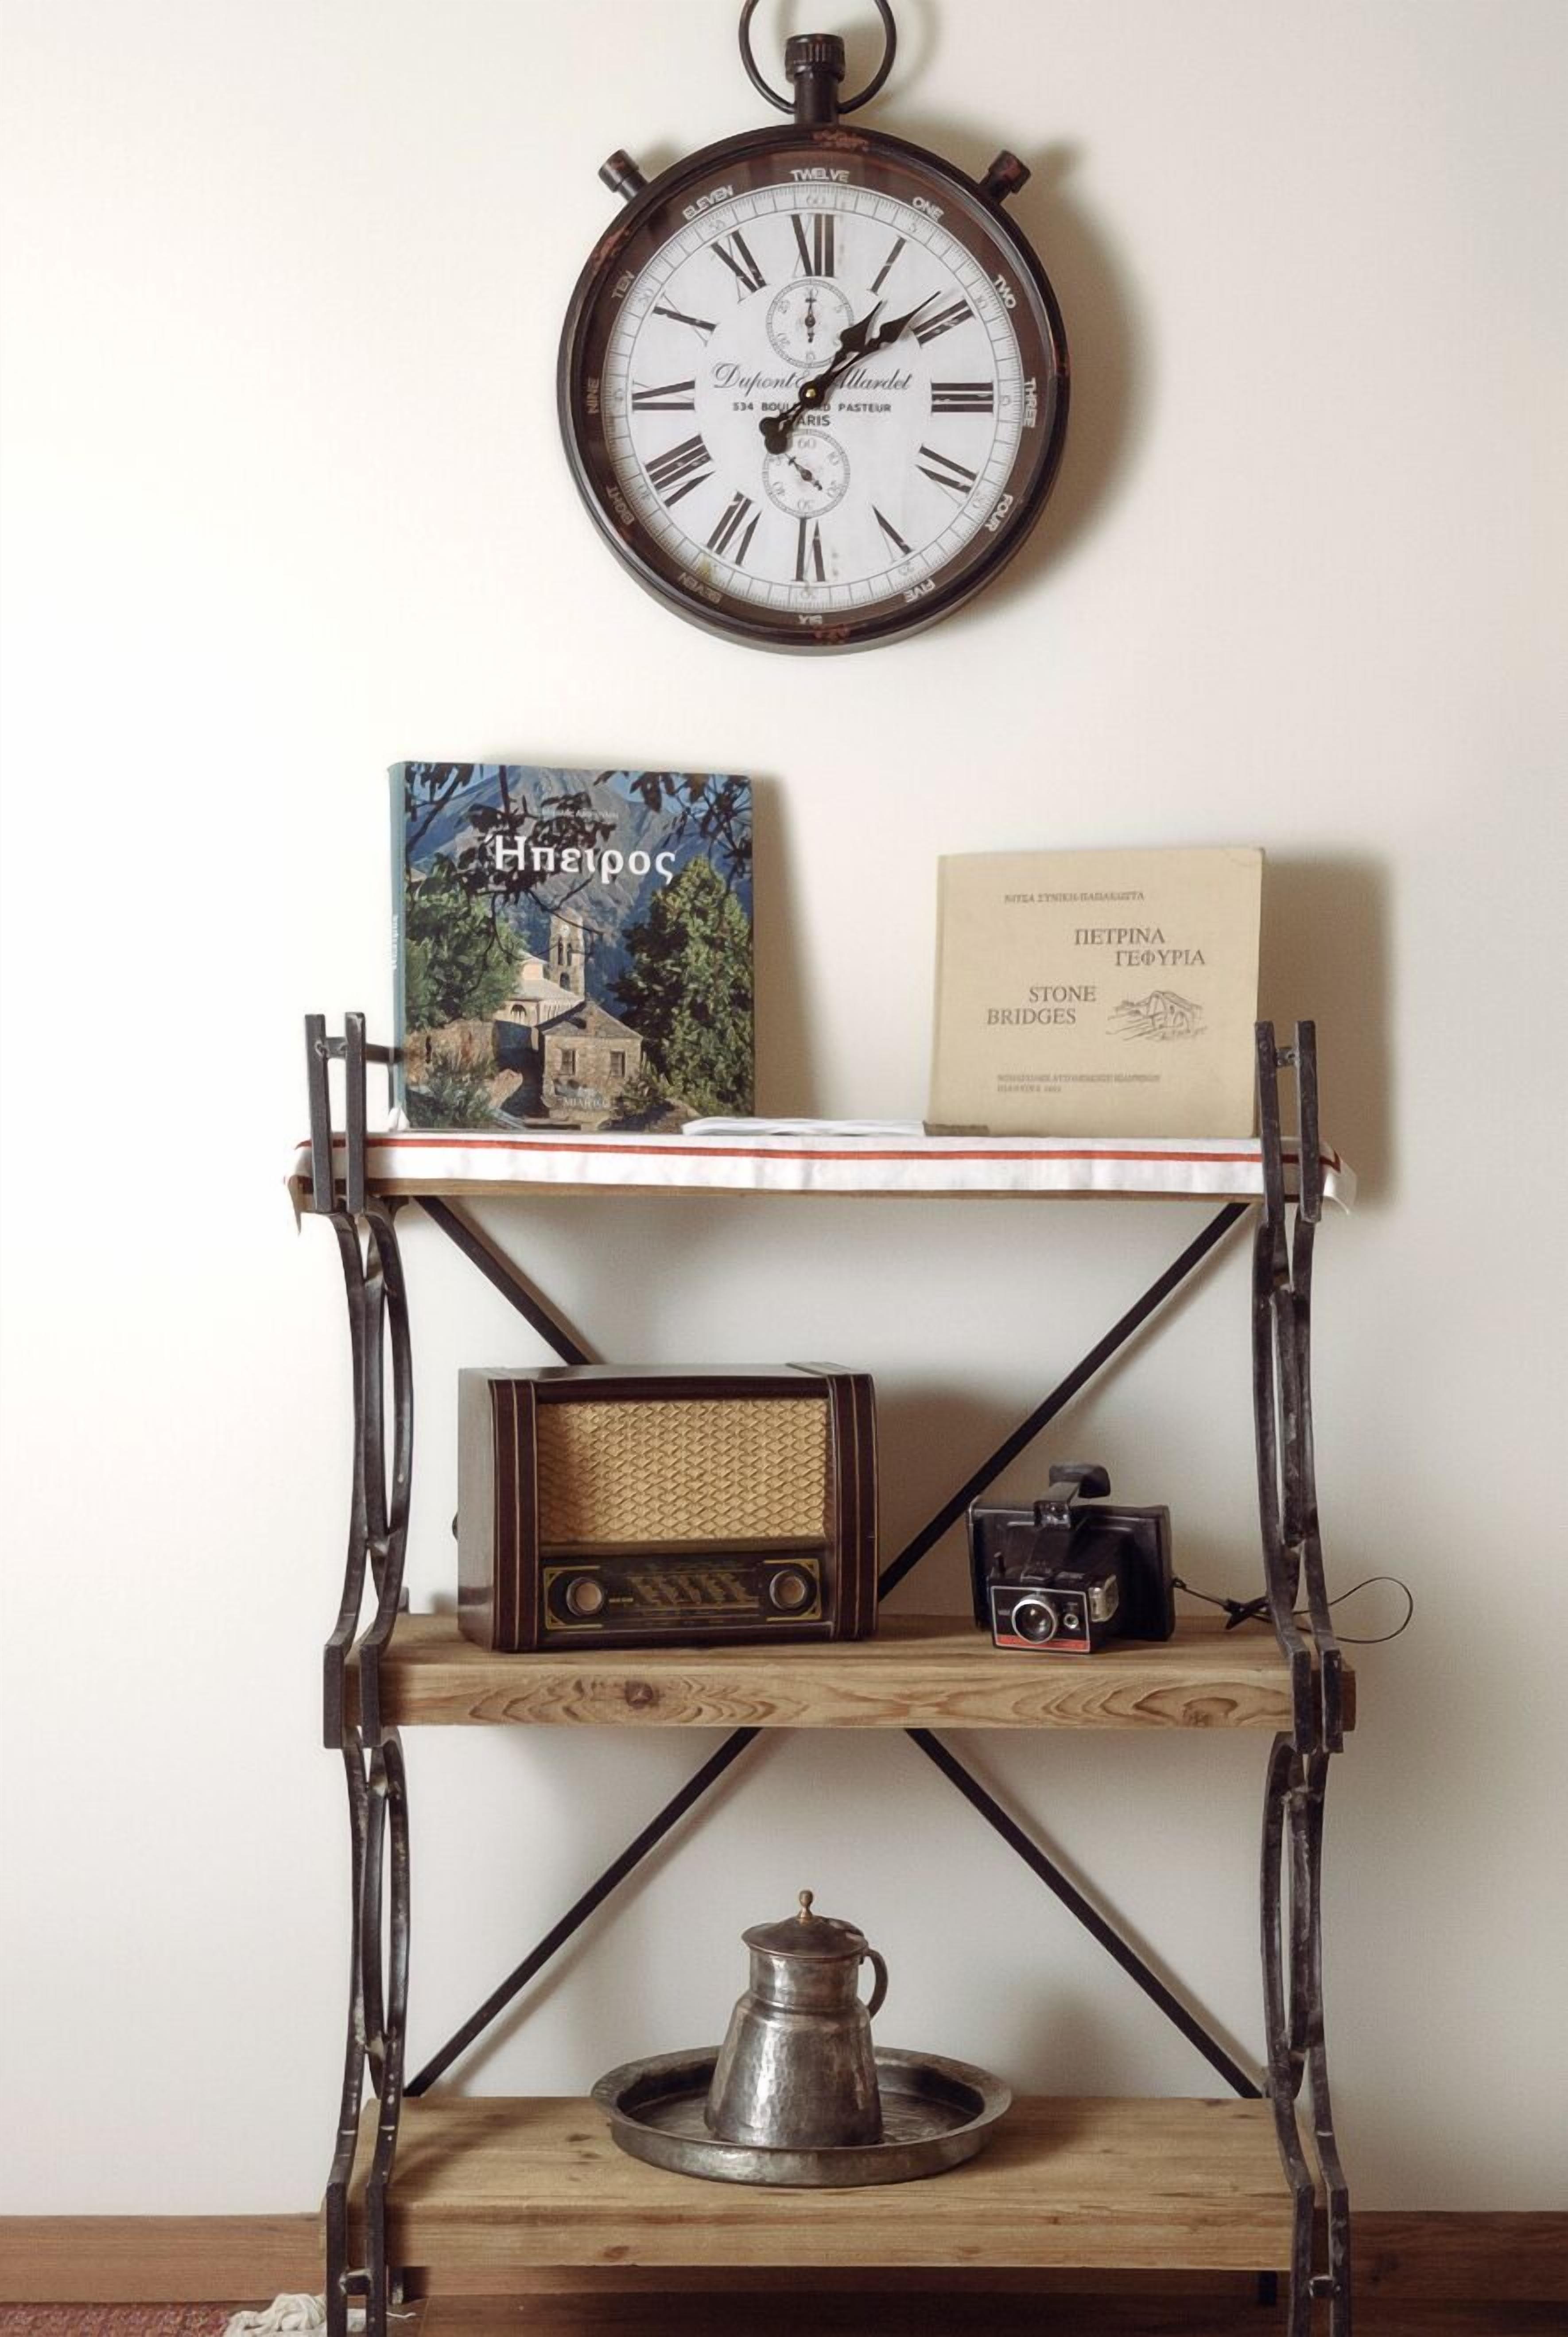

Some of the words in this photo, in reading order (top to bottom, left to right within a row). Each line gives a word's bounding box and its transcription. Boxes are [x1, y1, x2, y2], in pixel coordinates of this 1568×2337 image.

[790, 167, 850, 183] TWELVE
[683, 185, 734, 220] ELEVEN
[912, 197, 944, 221] ONE
[792, 213, 836, 278] XII
[710, 229, 767, 302] XI
[611, 271, 635, 299] TEN
[994, 274, 1017, 309] TWO
[911, 295, 976, 348] II
[587, 378, 600, 415] NINE
[631, 378, 696, 413] IX
[711, 361, 796, 397] Dupont
[761, 401, 831, 412] BOULD
[838, 403, 892, 413] PASTEUR
[931, 380, 994, 415] III
[1024, 377, 1037, 428] THREE
[796, 414, 831, 427] ARIS
[644, 432, 716, 508] VIII
[605, 485, 635, 525] EIGHT
[985, 493, 1013, 532] FOUR
[706, 490, 763, 567] VII
[792, 518, 827, 582] VI
[678, 572, 723, 604] SEVEN
[904, 579, 936, 603] FIVE
[799, 614, 823, 625] SIX
[484, 834, 675, 885] Ήπειρος
[1075, 927, 1165, 945] ΠΕΤΡΙΝΑ
[1115, 949, 1206, 966] ΓΕΦΥΡΙΑ
[1029, 986, 1097, 1003] STONE
[987, 1008, 1077, 1025] BRIDGES
